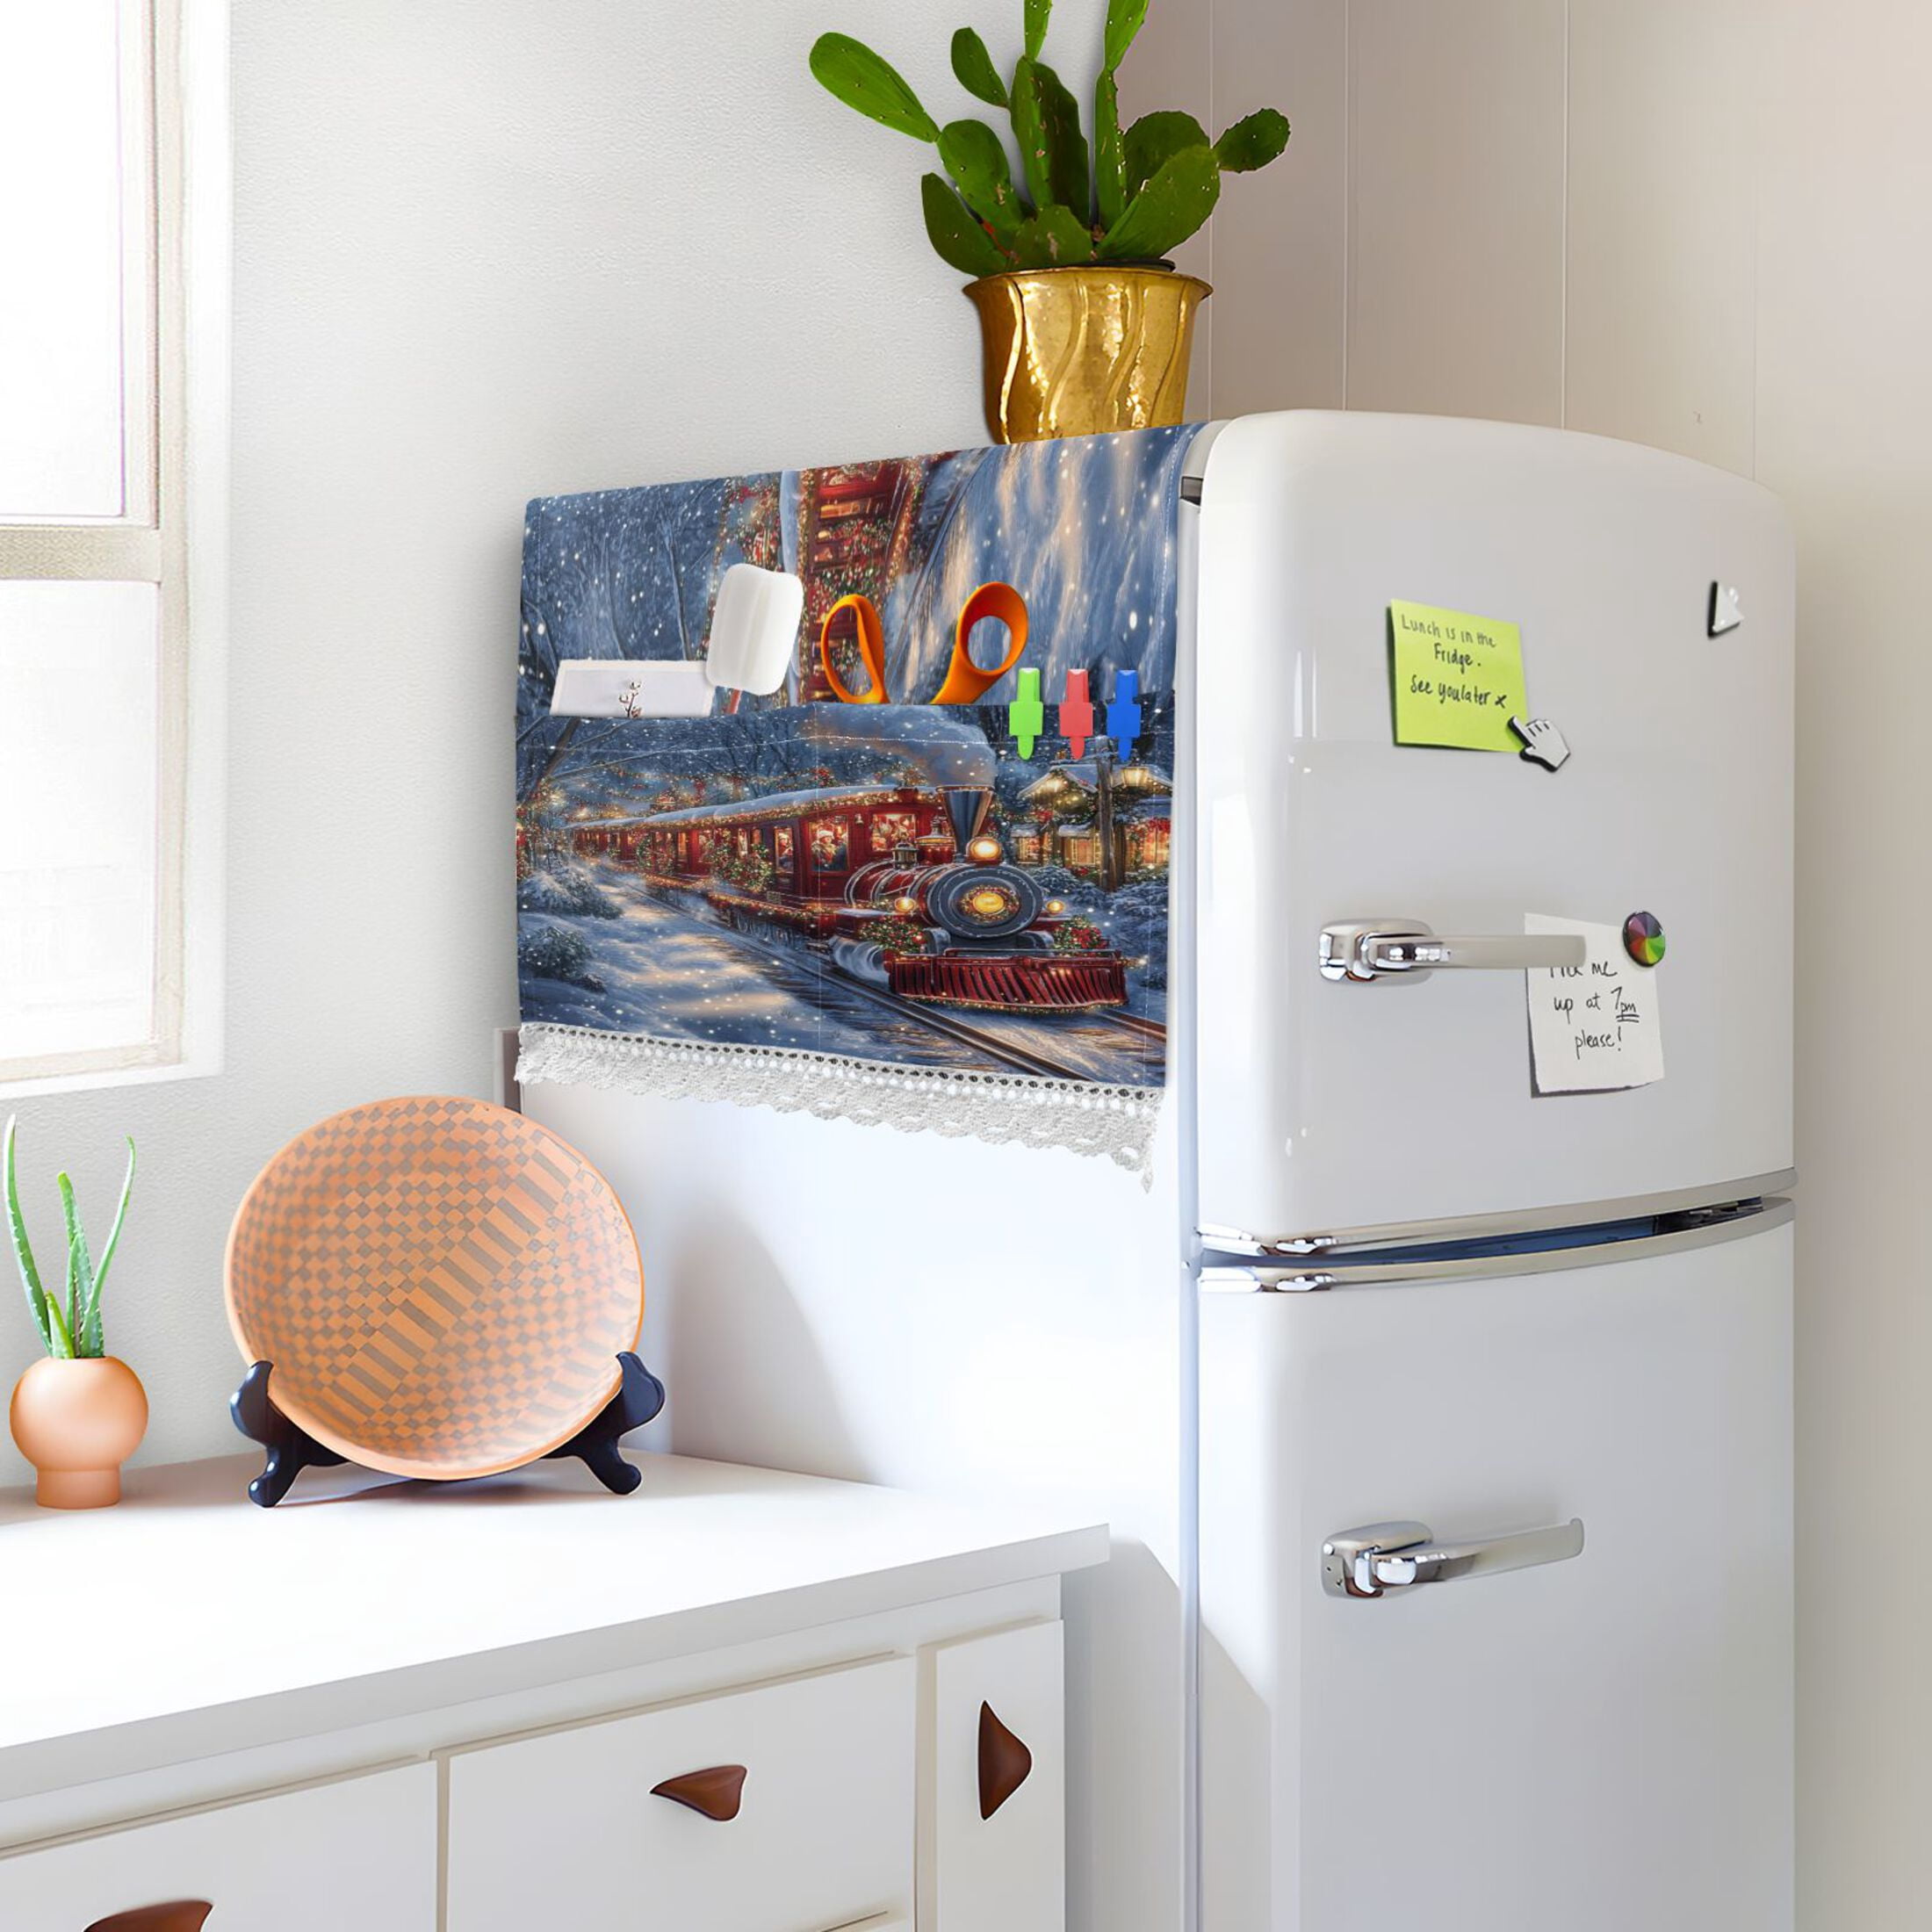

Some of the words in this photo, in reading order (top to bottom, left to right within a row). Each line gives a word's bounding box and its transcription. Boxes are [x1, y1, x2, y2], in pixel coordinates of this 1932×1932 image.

[1402, 614, 1440, 638] Lunch
[1445, 627, 1456, 640] is
[1460, 631, 1474, 643] in
[1476, 631, 1496, 648] the
[1410, 674, 1433, 695] See
[1591, 961, 1618, 977] me
[1553, 997, 1574, 1024] up
[1586, 992, 1601, 1010] at
[1575, 1026, 1622, 1060] please!
